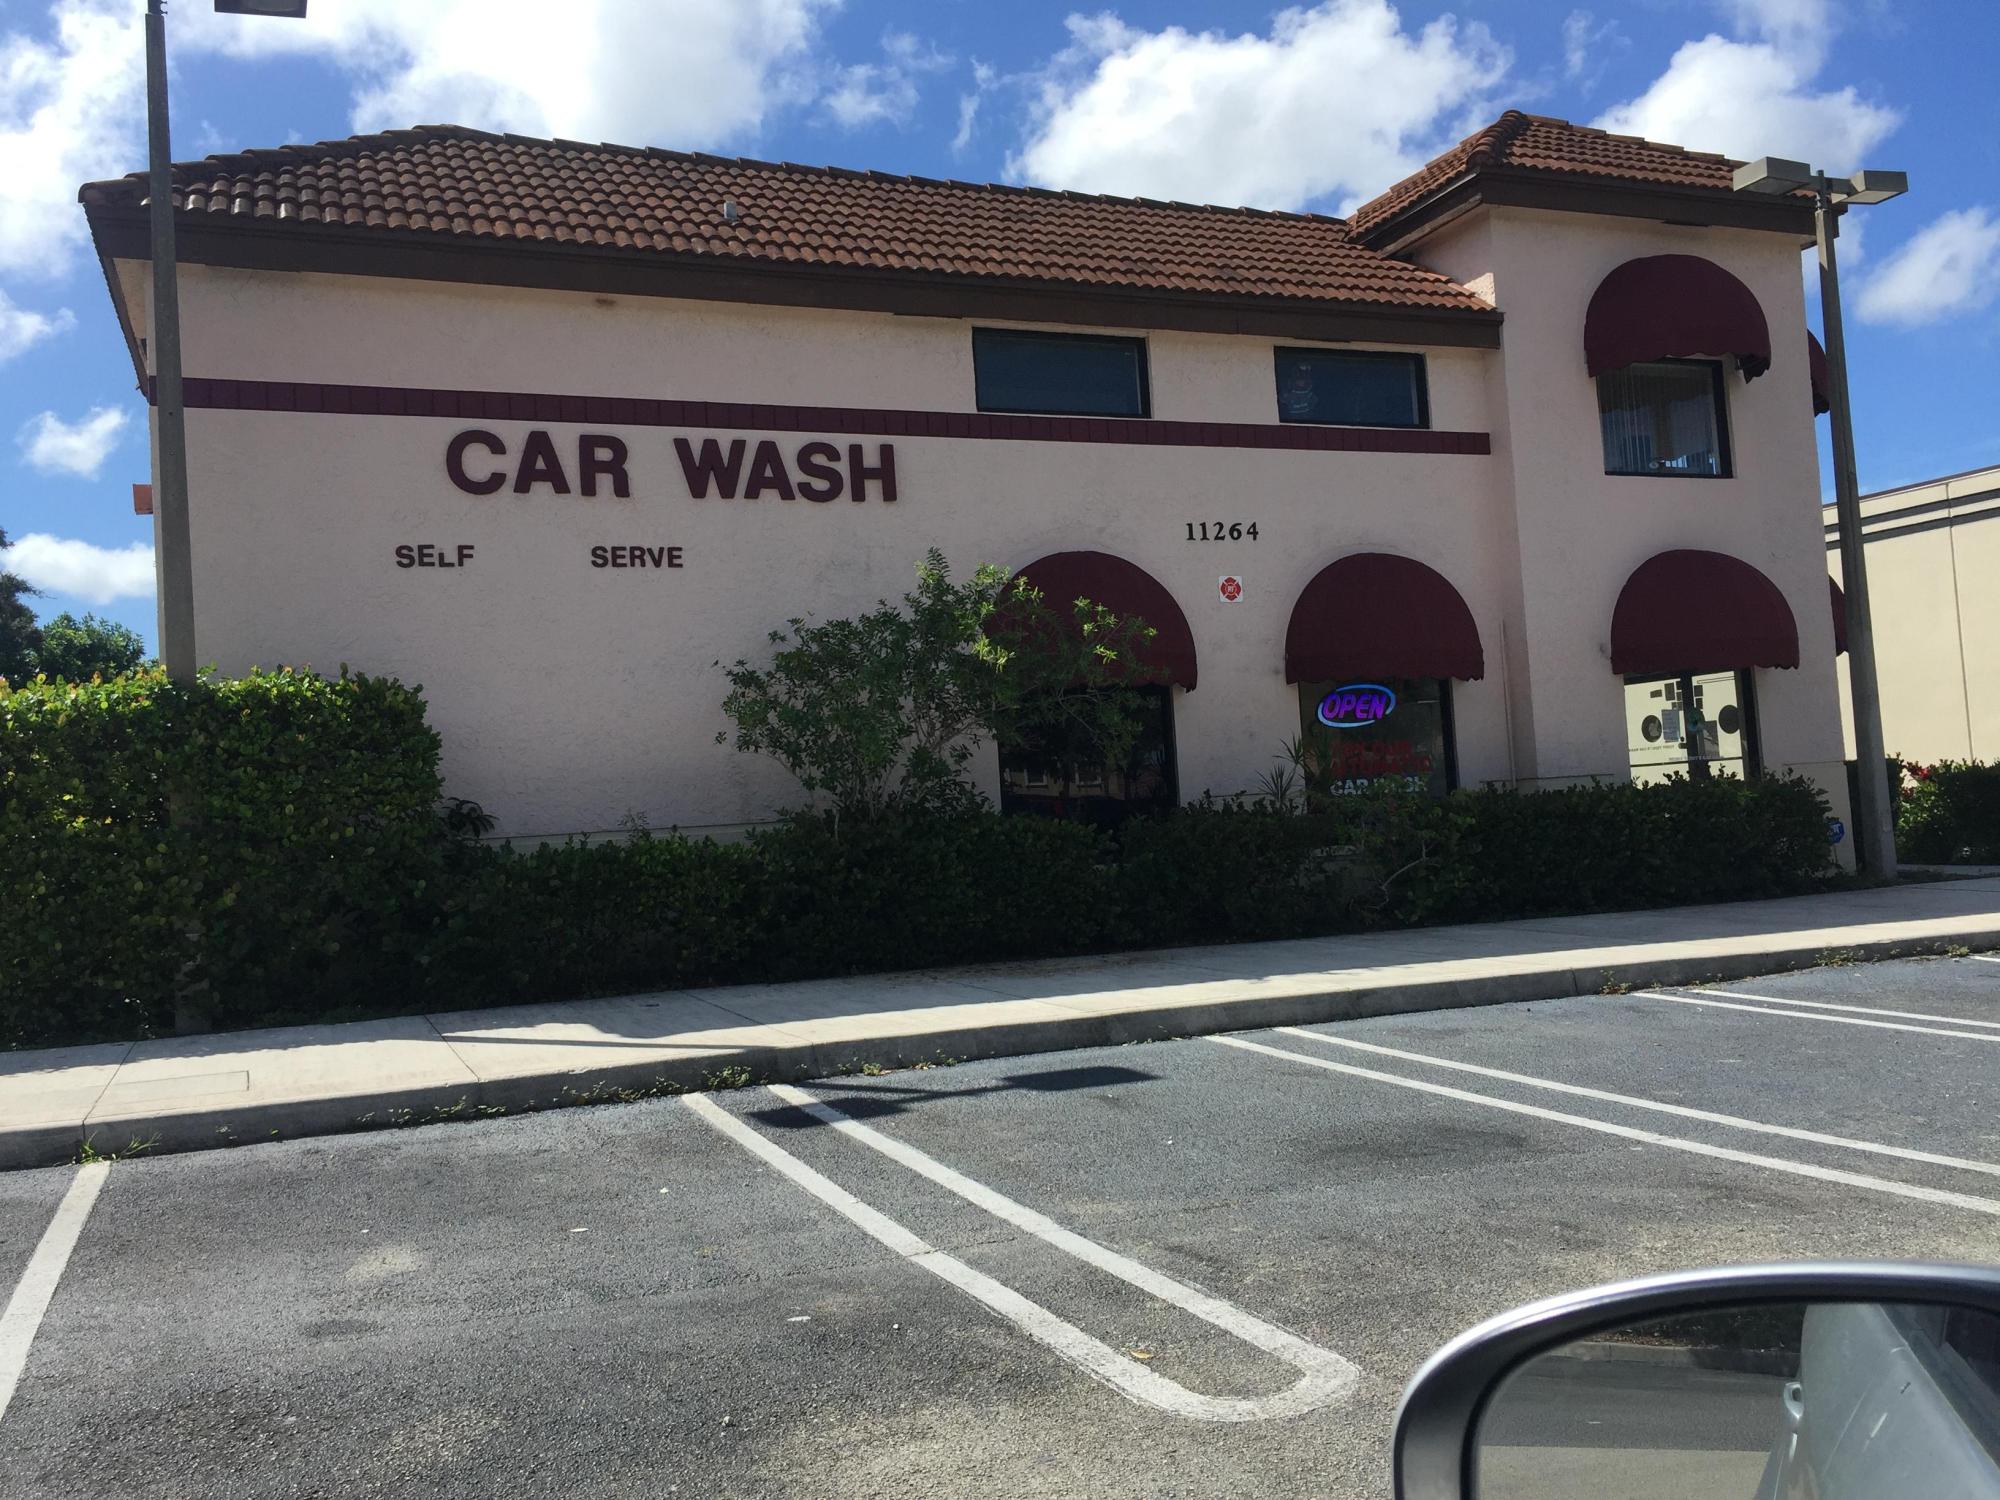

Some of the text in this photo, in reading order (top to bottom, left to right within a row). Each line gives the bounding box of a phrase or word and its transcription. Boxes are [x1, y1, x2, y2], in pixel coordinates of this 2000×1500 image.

[446, 430, 898, 502] CAR WASH
[1186, 521, 1259, 541] 11264
[395, 544, 684, 568] SELF SERVE
[1322, 693, 1386, 719] OPEN
[1329, 778, 1369, 797] CAR
